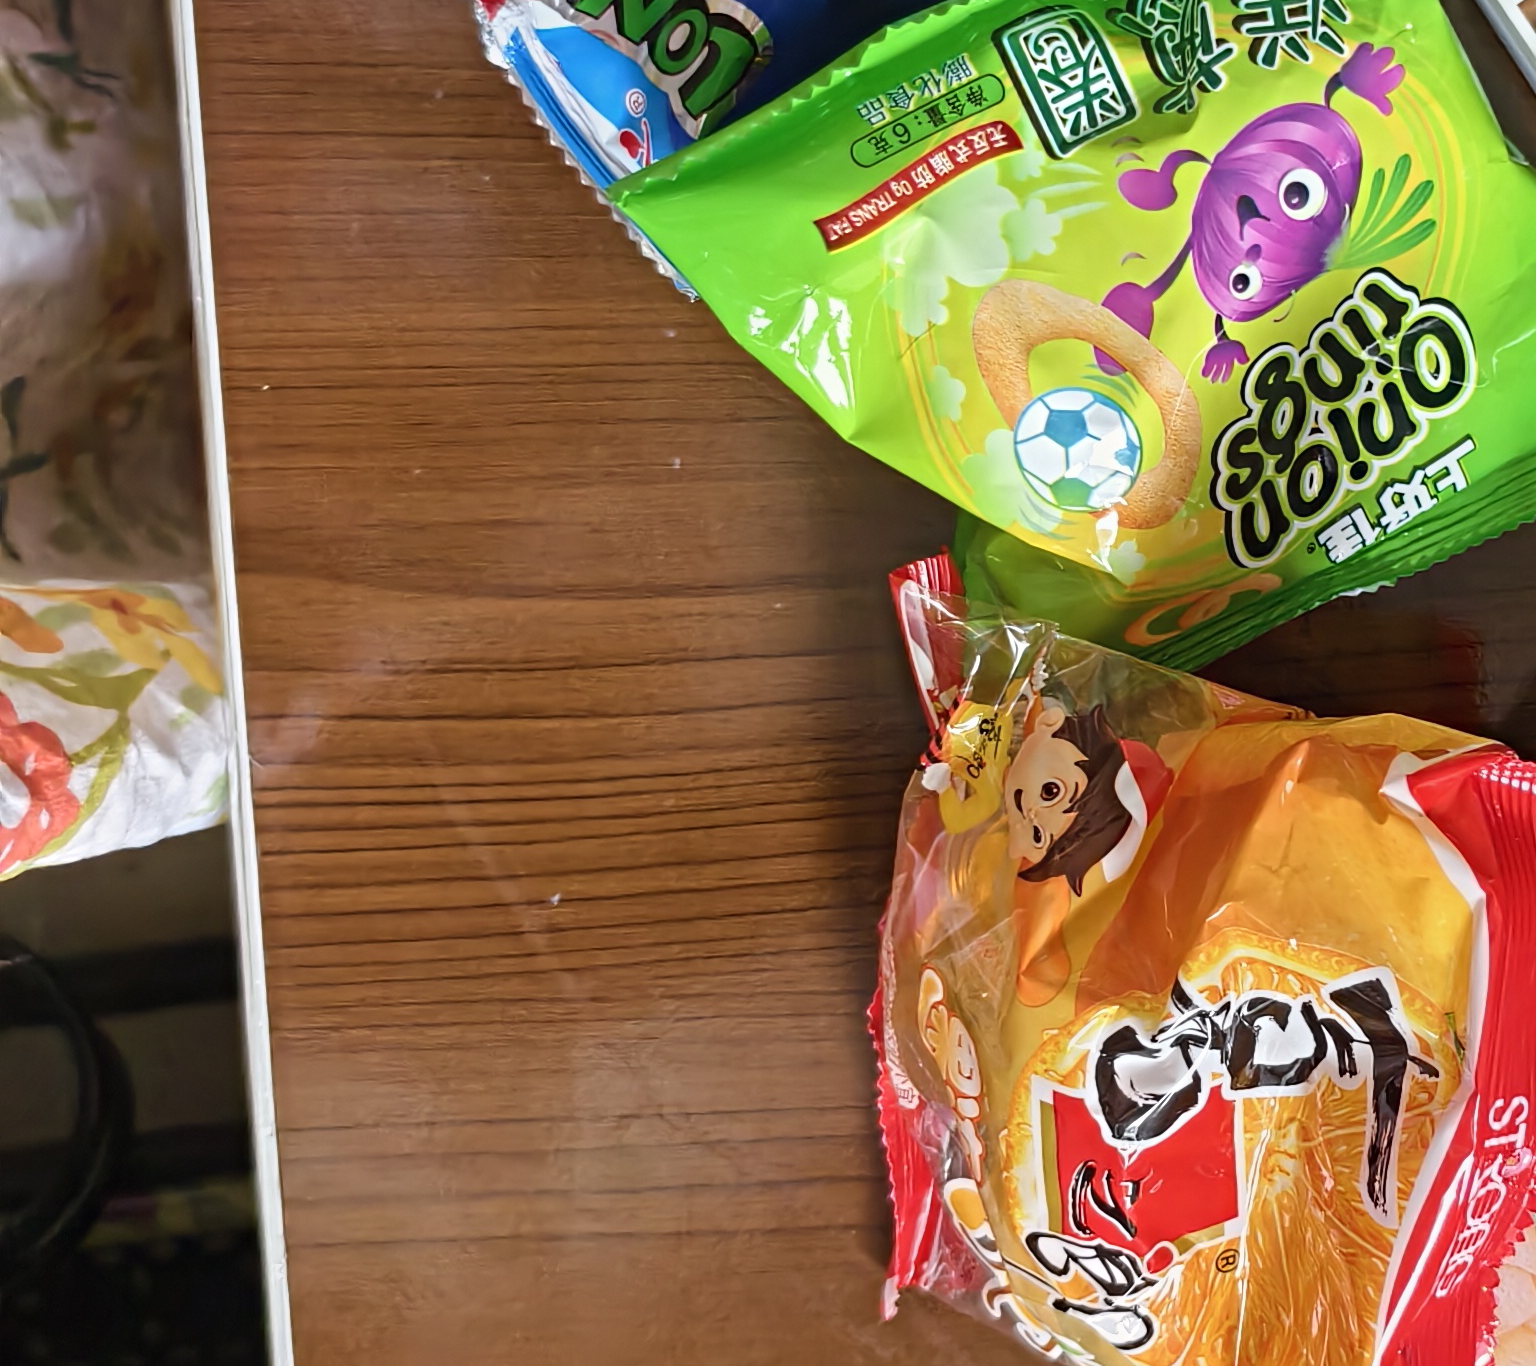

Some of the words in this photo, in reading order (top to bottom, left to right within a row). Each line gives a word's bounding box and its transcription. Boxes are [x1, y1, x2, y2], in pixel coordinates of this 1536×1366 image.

[855, 54, 976, 126] 膨化食品
[853, 188, 895, 226] TRANS
[913, 122, 1009, 191] 无反式脂肪
[1224, 282, 1416, 500] rings
[1236, 314, 1472, 562] Onion
[1316, 433, 1478, 565] 上好佳
